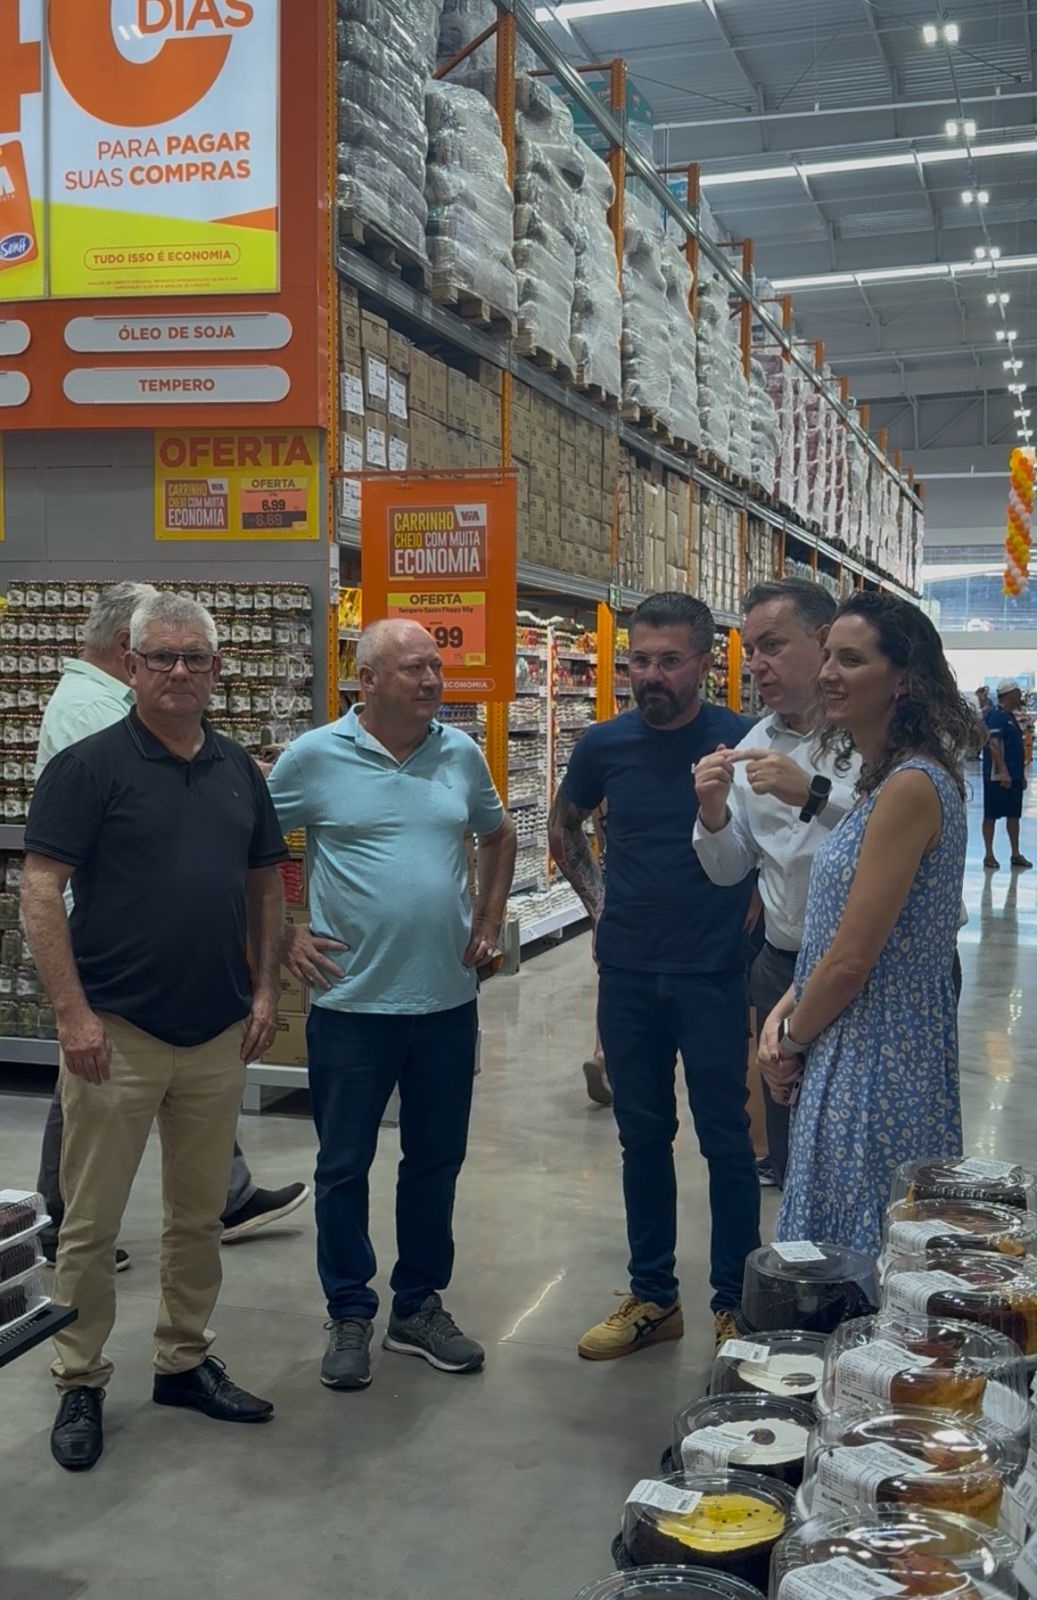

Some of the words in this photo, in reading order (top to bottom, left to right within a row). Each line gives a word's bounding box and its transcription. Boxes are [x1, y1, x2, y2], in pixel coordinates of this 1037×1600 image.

[137, 0, 254, 34] DIAS
[98, 139, 160, 160] PARA
[166, 131, 251, 155] PAGAR
[64, 168, 123, 190] SUAS
[129, 159, 251, 186] COMPRAS
[93, 255, 125, 265] TUDO
[128, 253, 154, 263] ISSO
[157, 249, 165, 262] É
[168, 250, 231, 262] ECONOMIA
[118, 325, 162, 341] ÓLEO
[168, 326, 189, 340] DE
[194, 325, 235, 339] SOJA
[139, 378, 215, 392] TEMPERO
[159, 436, 313, 468] OFERTA
[168, 482, 208, 497] CARRINHO
[251, 478, 296, 489] OFERTA
[168, 508, 225, 526] ECONOMIA
[394, 511, 455, 531] CARRINHO
[394, 532, 423, 548] CHEIO
[425, 532, 447, 547] COM
[449, 531, 480, 546] MUITA
[394, 547, 480, 574] ECONOMIA
[409, 594, 462, 605] OFERTA
[443, 681, 488, 690] ECONOMIA
